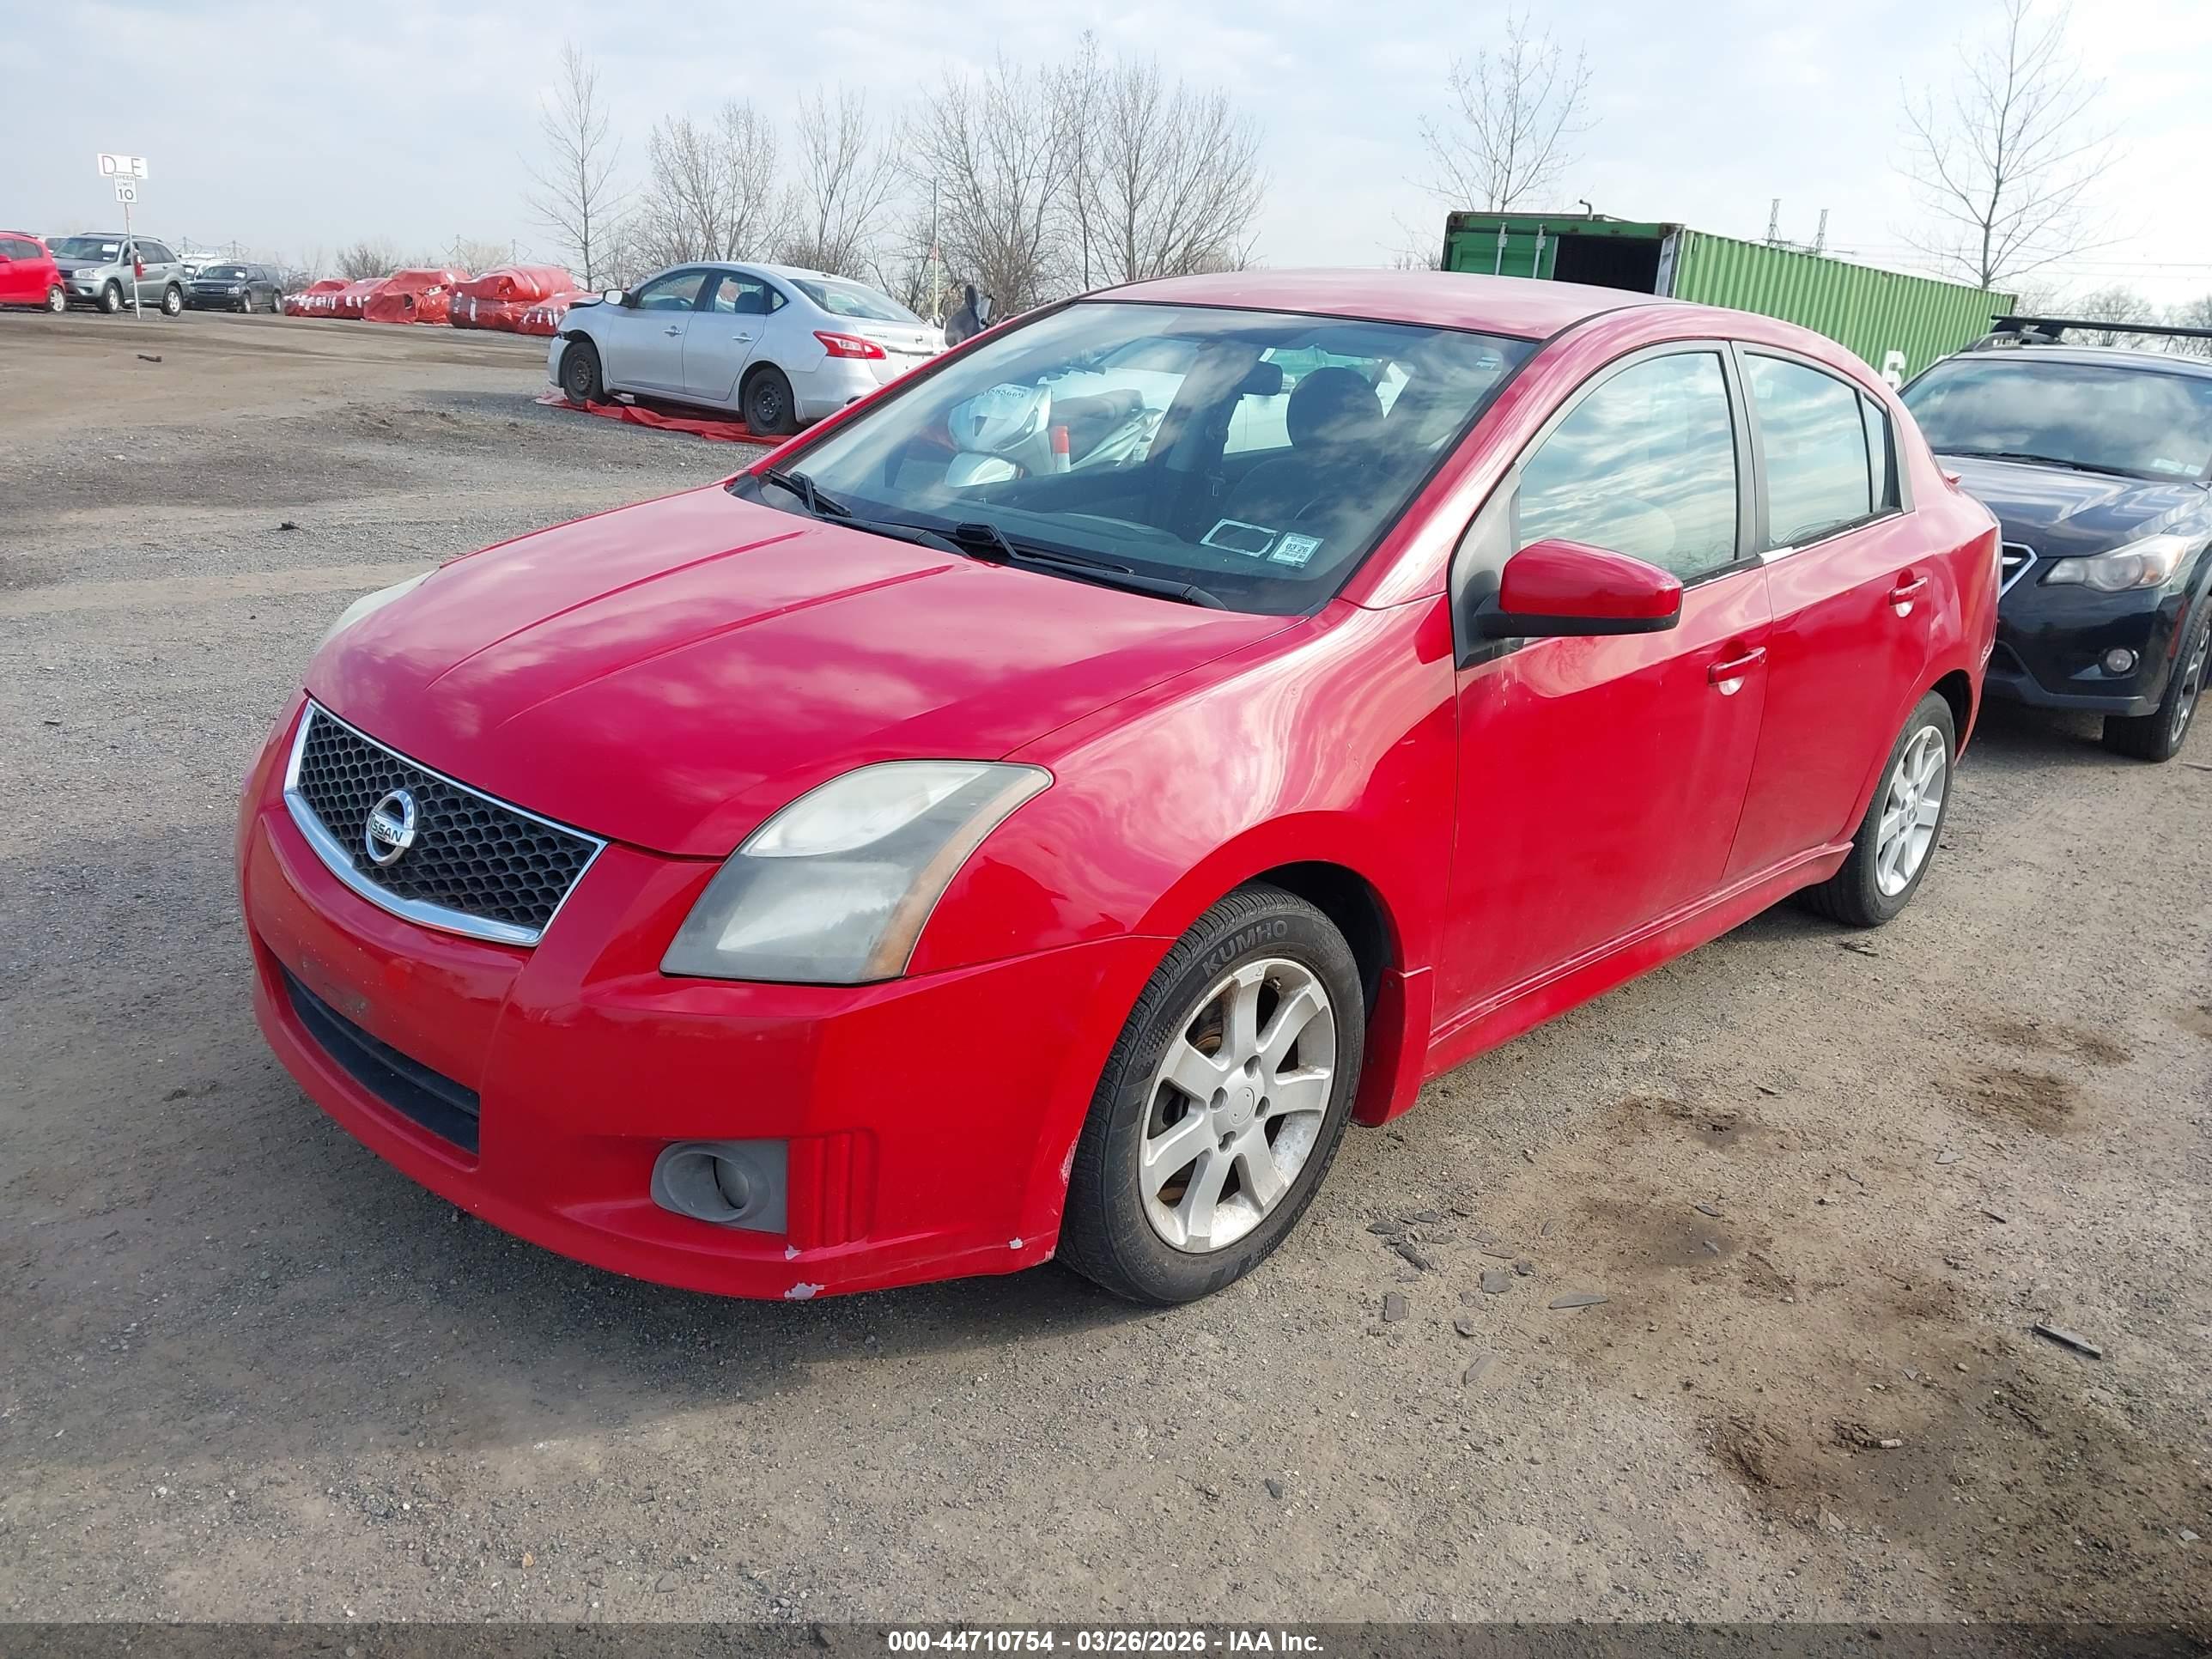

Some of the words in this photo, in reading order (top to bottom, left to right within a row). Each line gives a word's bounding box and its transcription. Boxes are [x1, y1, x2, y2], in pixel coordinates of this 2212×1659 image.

[101, 155, 117, 174] D
[131, 157, 143, 178] E
[118, 188, 134, 200] 10
[369, 813, 404, 842] NISSAN
[1202, 920, 1288, 978] KUMHO
